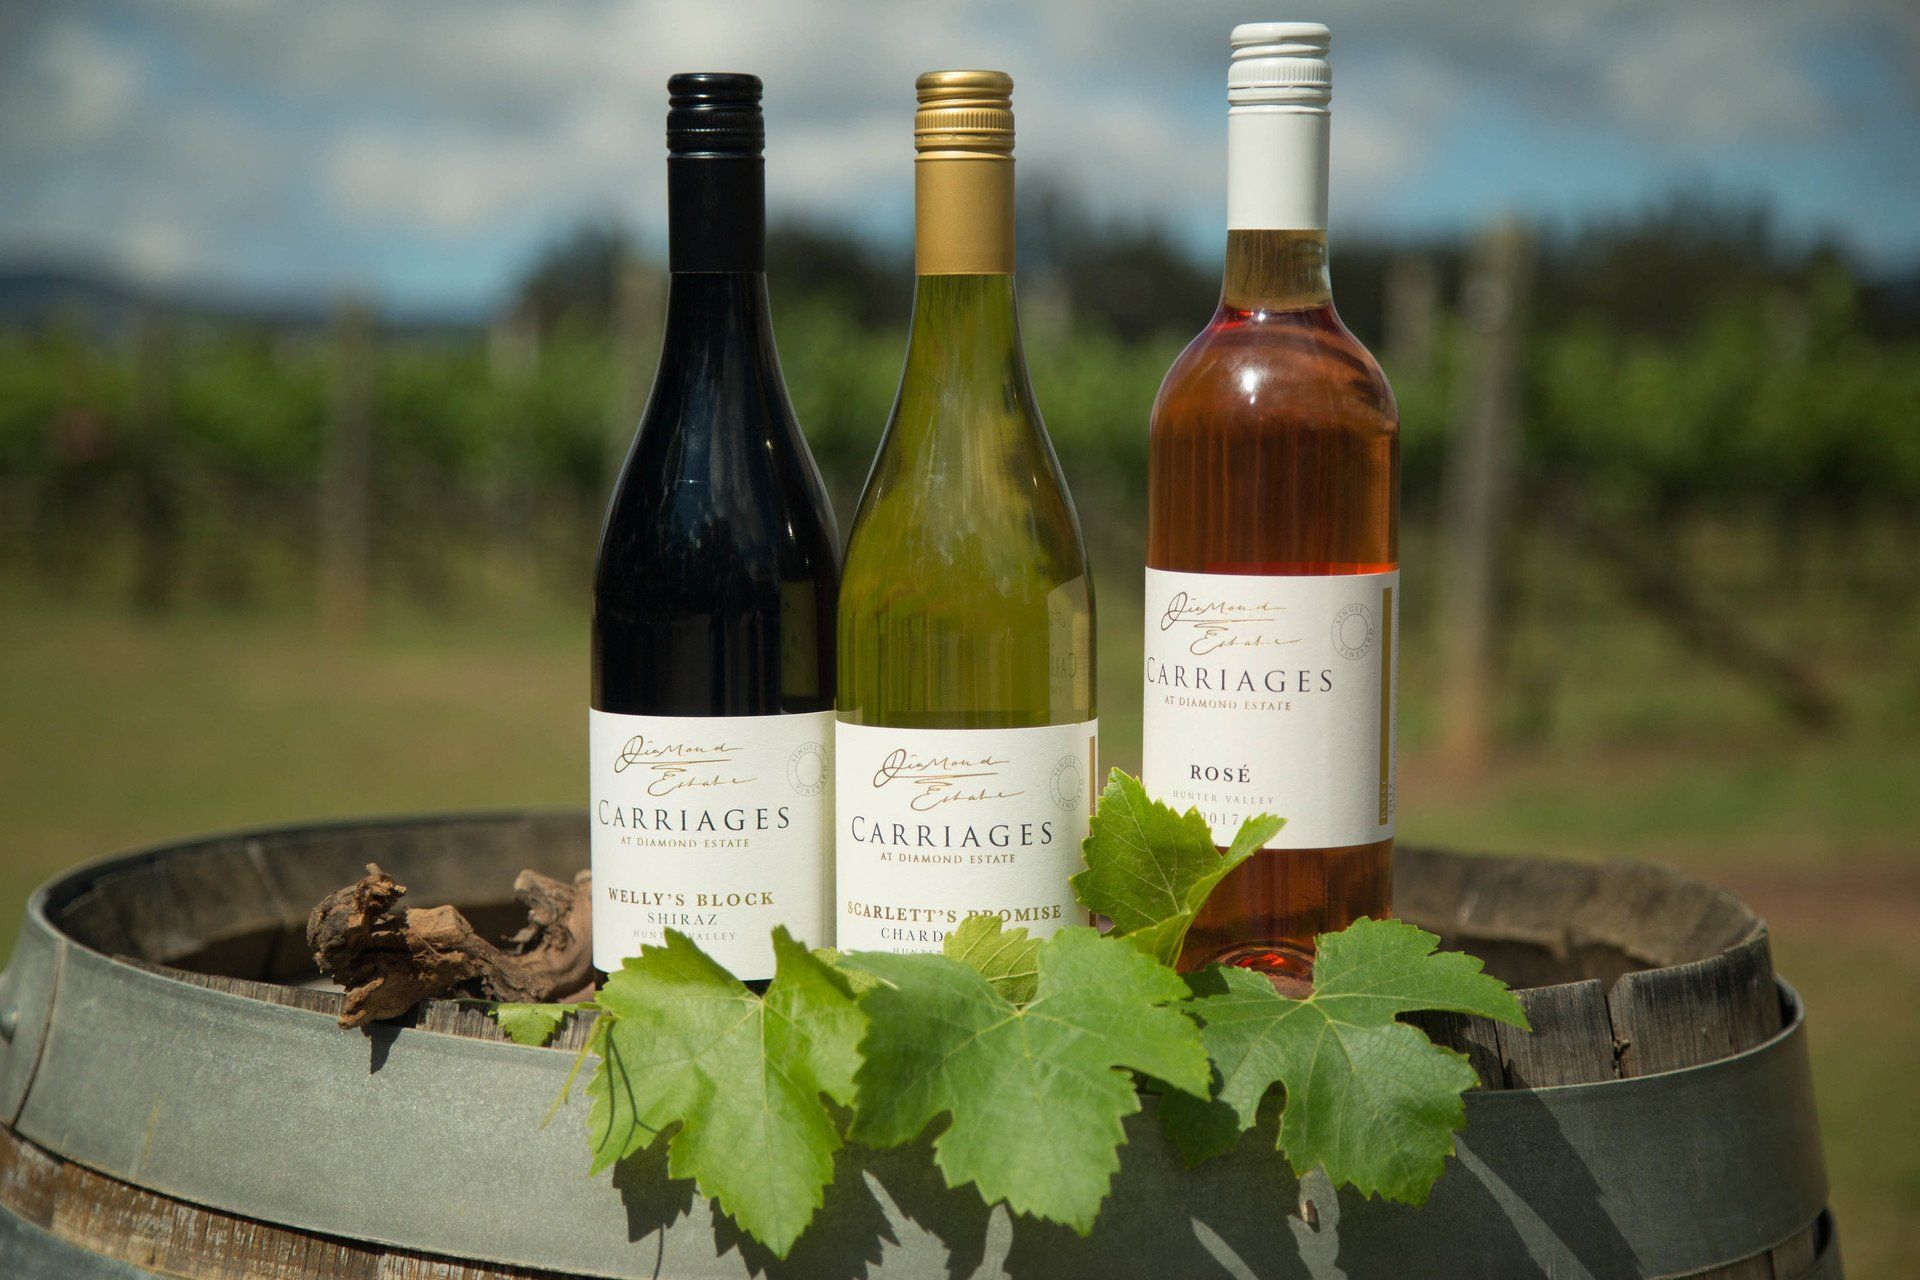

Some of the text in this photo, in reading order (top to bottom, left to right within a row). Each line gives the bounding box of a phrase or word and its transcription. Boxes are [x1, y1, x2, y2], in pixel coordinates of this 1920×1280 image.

[1146, 656, 1333, 693] CARRIAGES
[1164, 695, 1292, 711] AT DIAMOND ESTATE
[1190, 763, 1251, 783] ROSÉ
[1172, 789, 1274, 805] HUNTER VALLEY
[599, 799, 790, 832] CARRIAGES
[851, 815, 1053, 848] CARRIAGES
[621, 836, 750, 848] AT DIAMOND ESTATE
[880, 852, 1016, 864] AT DIAMOND ESTATE
[608, 887, 775, 907] WELLY'S BLOCK
[647, 912, 719, 926] SHIRAZ
[847, 900, 957, 923] SCARLETT'S
[633, 930, 663, 940] HUNT
[880, 927, 944, 943] CHARD
